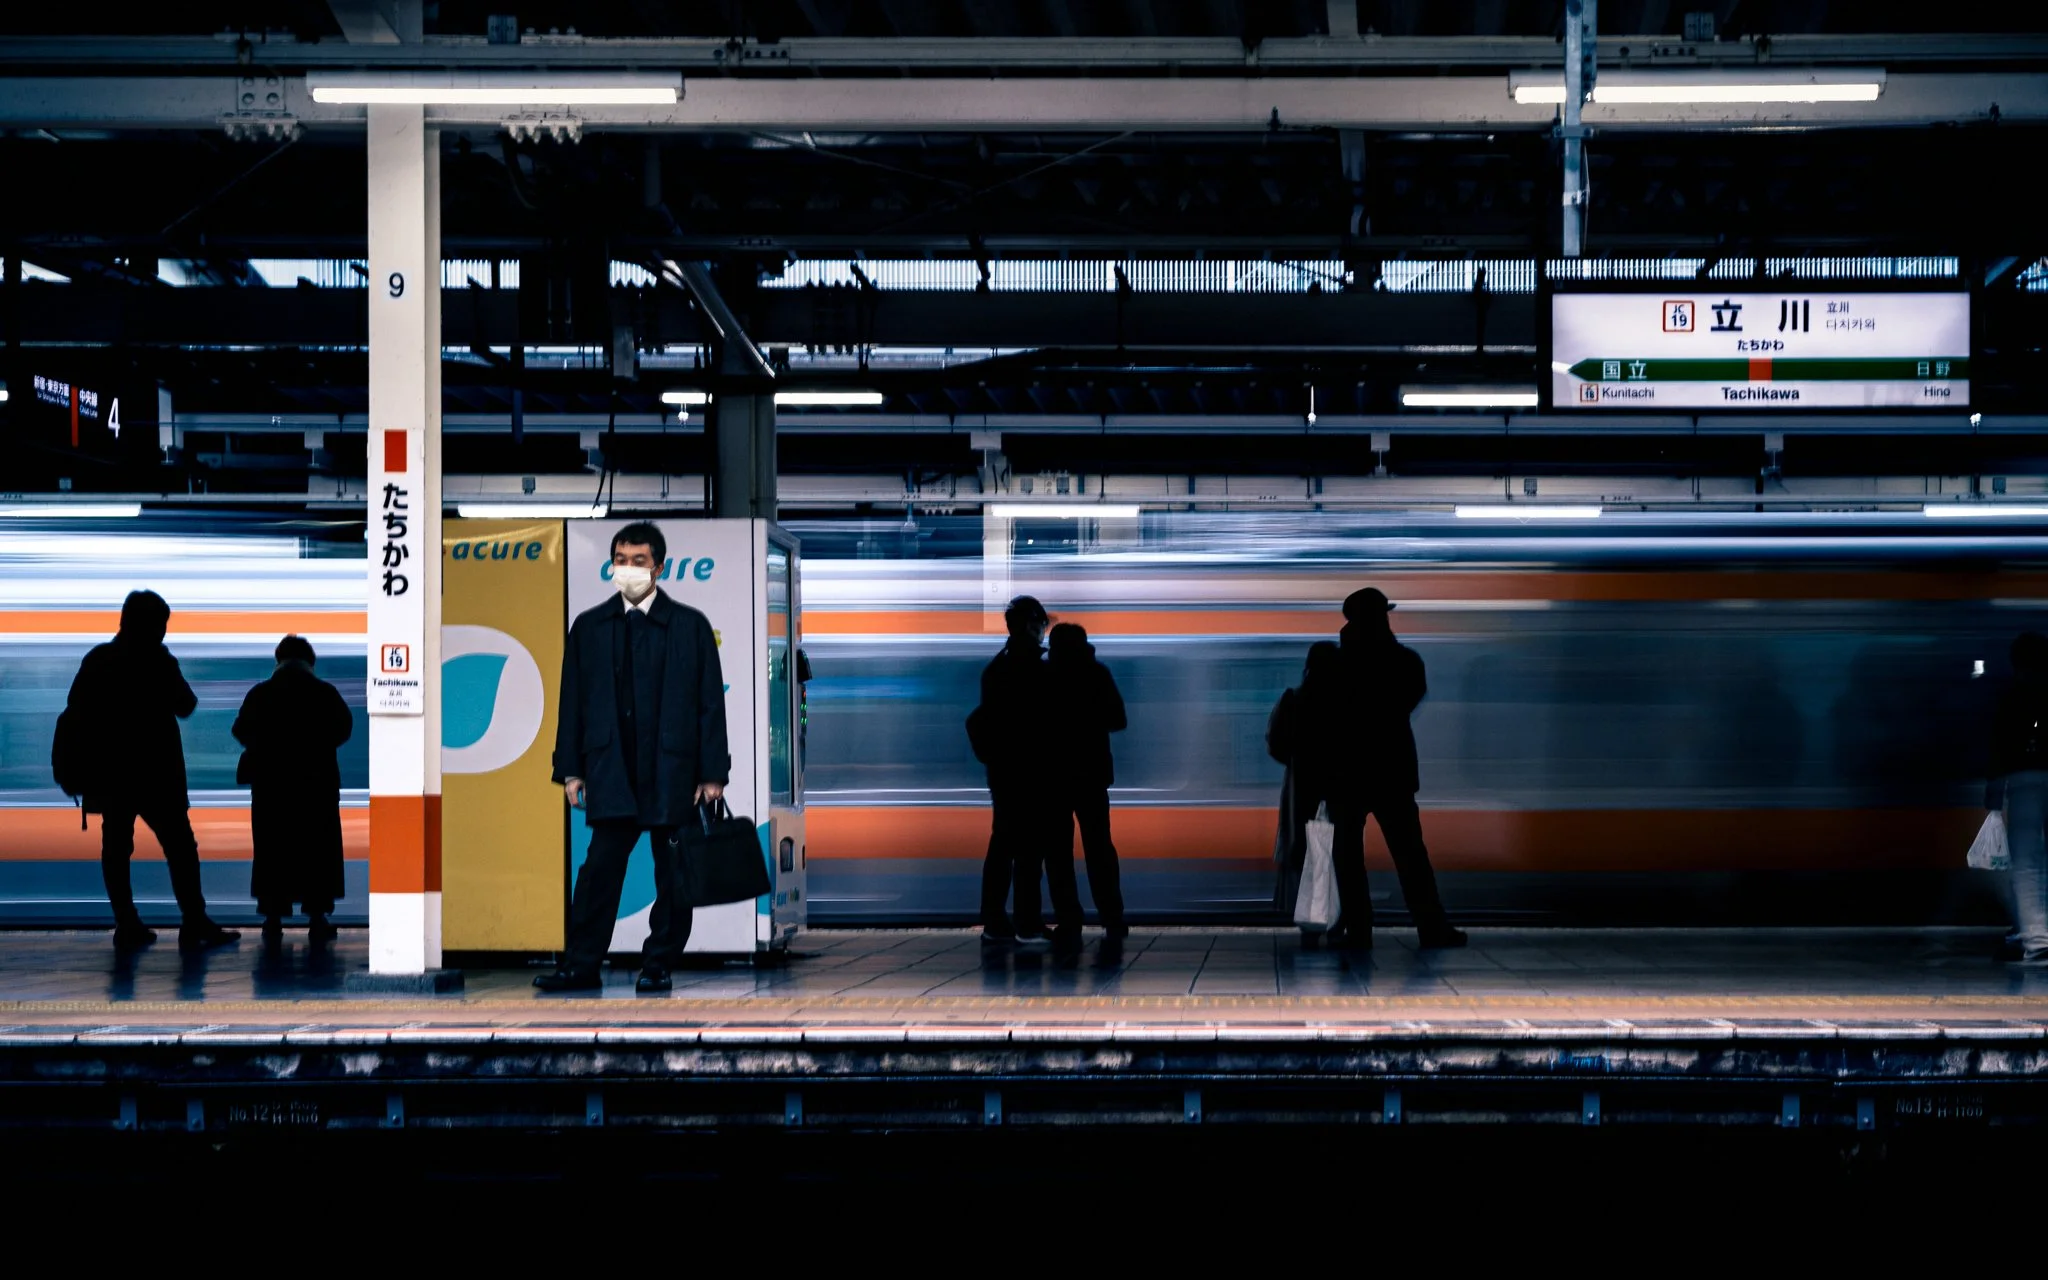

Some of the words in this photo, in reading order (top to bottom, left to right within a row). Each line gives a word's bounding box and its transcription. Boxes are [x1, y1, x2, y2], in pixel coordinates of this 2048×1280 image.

[389, 272, 405, 298] 9
[1673, 304, 1685, 314] JC
[1827, 301, 1849, 313] 立川
[1671, 314, 1688, 327] 19
[1710, 299, 1809, 333] 立川
[1826, 318, 1875, 331] 다치카와
[1737, 339, 1784, 351] たちかわ
[1603, 360, 1646, 379] 国立
[1917, 361, 1950, 377] 日野
[1602, 387, 1655, 398] Kunitachi
[1721, 387, 1800, 400] Tachikawa
[1924, 386, 1950, 397] Hino
[107, 396, 121, 439] 4
[382, 483, 409, 596] たちかわ
[452, 541, 543, 560] acure
[600, 557, 715, 581] aure
[391, 647, 401, 655] JC
[389, 656, 403, 667] 19
[372, 678, 419, 687] Tachikawa
